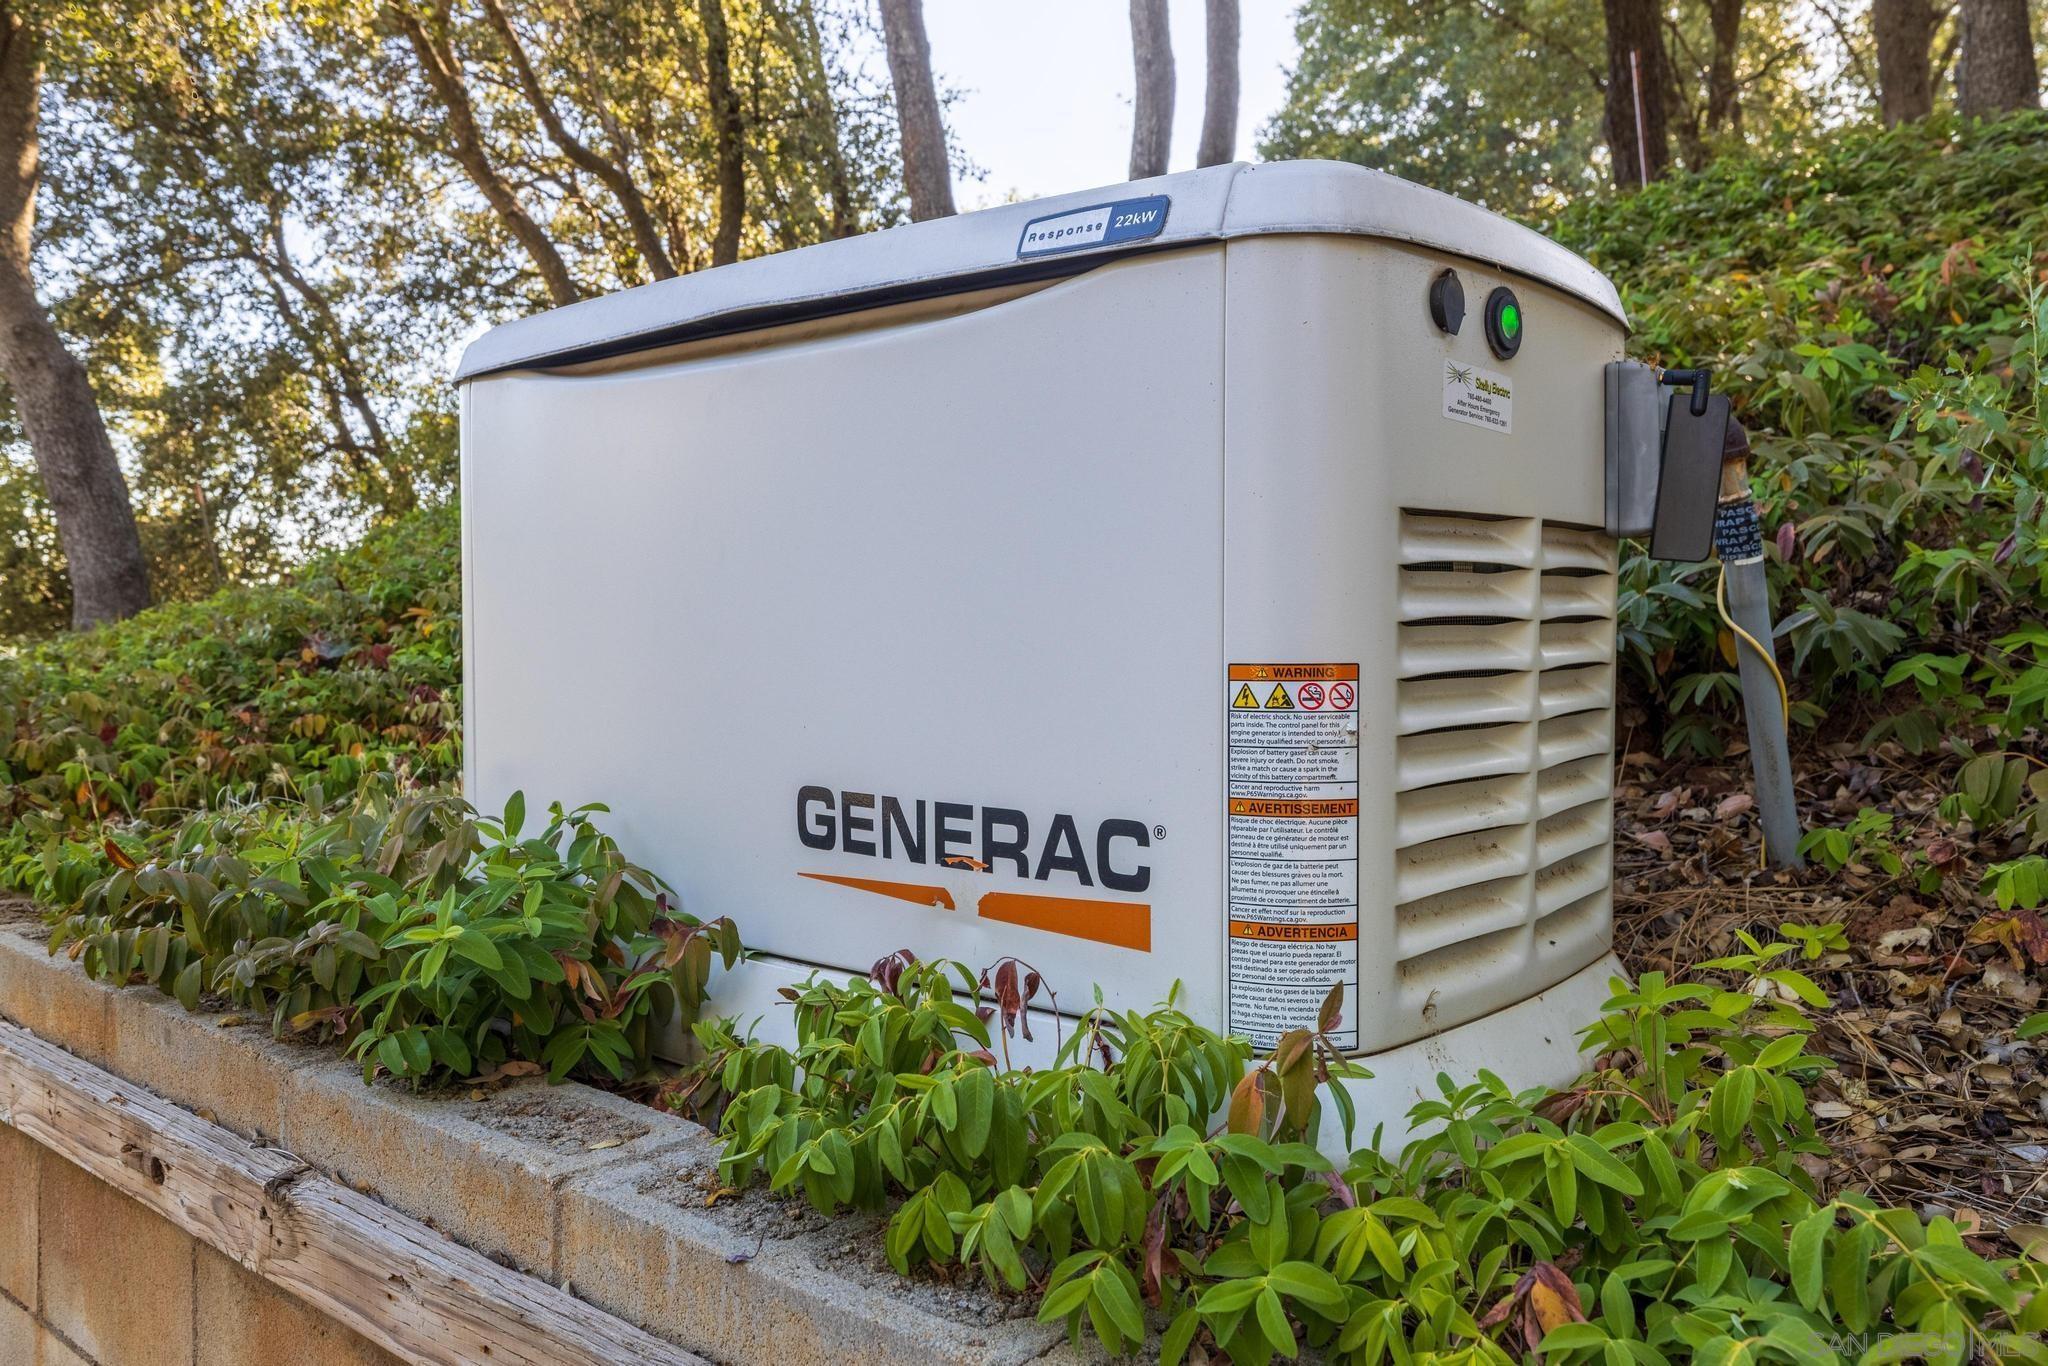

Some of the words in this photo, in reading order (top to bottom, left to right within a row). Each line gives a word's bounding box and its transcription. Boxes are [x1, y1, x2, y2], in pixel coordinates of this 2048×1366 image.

[1028, 222, 1103, 242] Response
[1114, 209, 1157, 227] 22kW
[1448, 406, 1468, 416] Generator
[1468, 402, 1479, 411] Hours
[1480, 406, 1500, 418] Emergency
[1273, 668, 1335, 677] WARNING
[1250, 757, 1266, 765] injury
[1272, 774, 1293, 782] battery
[1249, 803, 1353, 814] AVERTISSEMENT
[1258, 927, 1347, 938] ADVERTENCIA
[1232, 939, 1249, 947] Riesgo
[1260, 941, 1286, 950] descarga
[1239, 985, 1264, 994] explosión
[1252, 1012, 1272, 1020] chispas
[1232, 1019, 1274, 1028] compartimiento
